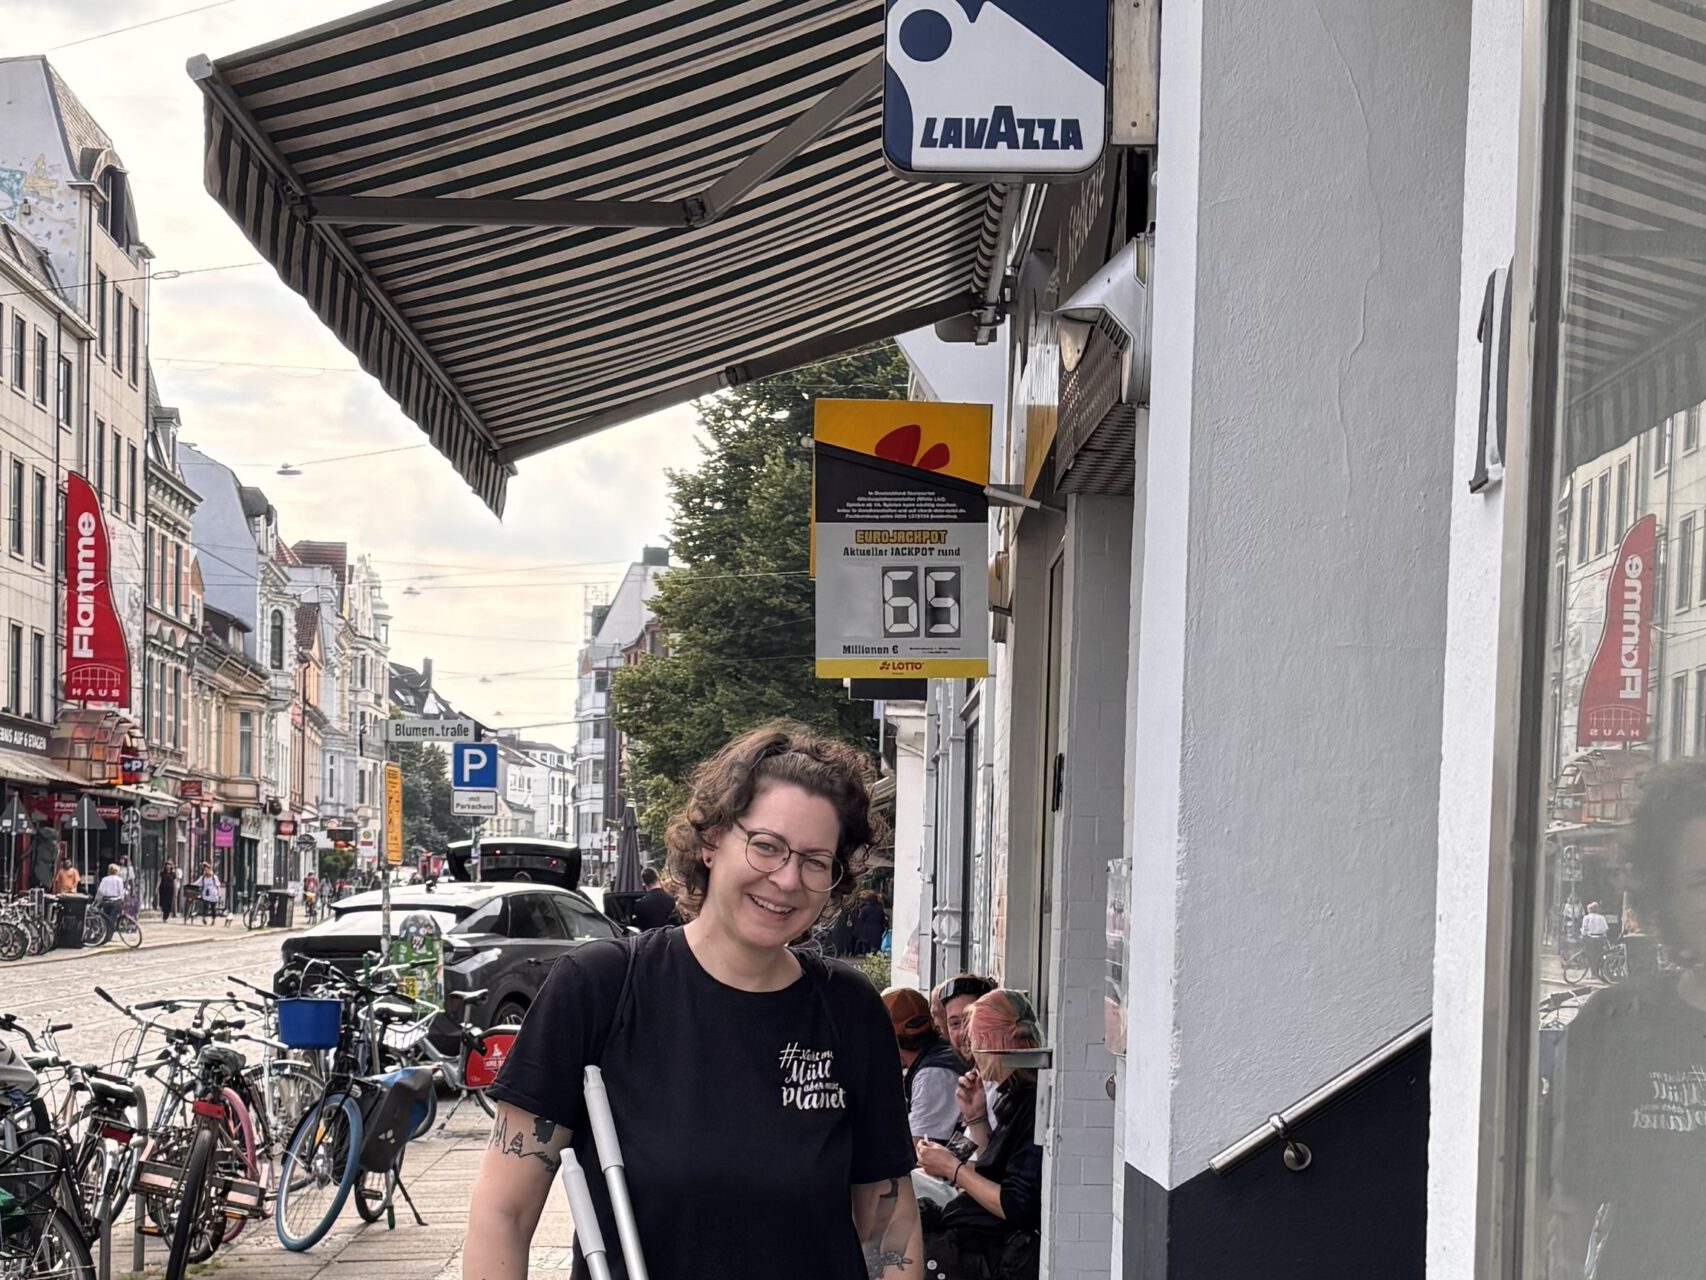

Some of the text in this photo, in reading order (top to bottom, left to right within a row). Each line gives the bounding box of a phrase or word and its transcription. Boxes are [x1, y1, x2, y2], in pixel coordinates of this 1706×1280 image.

[920, 105, 1084, 150] LAVAZZA
[842, 547, 961, 557] Aktueller JACKPOT rund
[72, 511, 96, 659] Flamme
[882, 570, 960, 634] 65
[842, 645, 889, 655] Millionen
[892, 645, 899, 654] €
[892, 662, 923, 671] LOTTO
[71, 688, 121, 698] HAUS
[394, 723, 470, 738] Blumentraße
[463, 748, 488, 783] P
[784, 1059, 832, 1085] Müll
[781, 1086, 847, 1110] Planet
